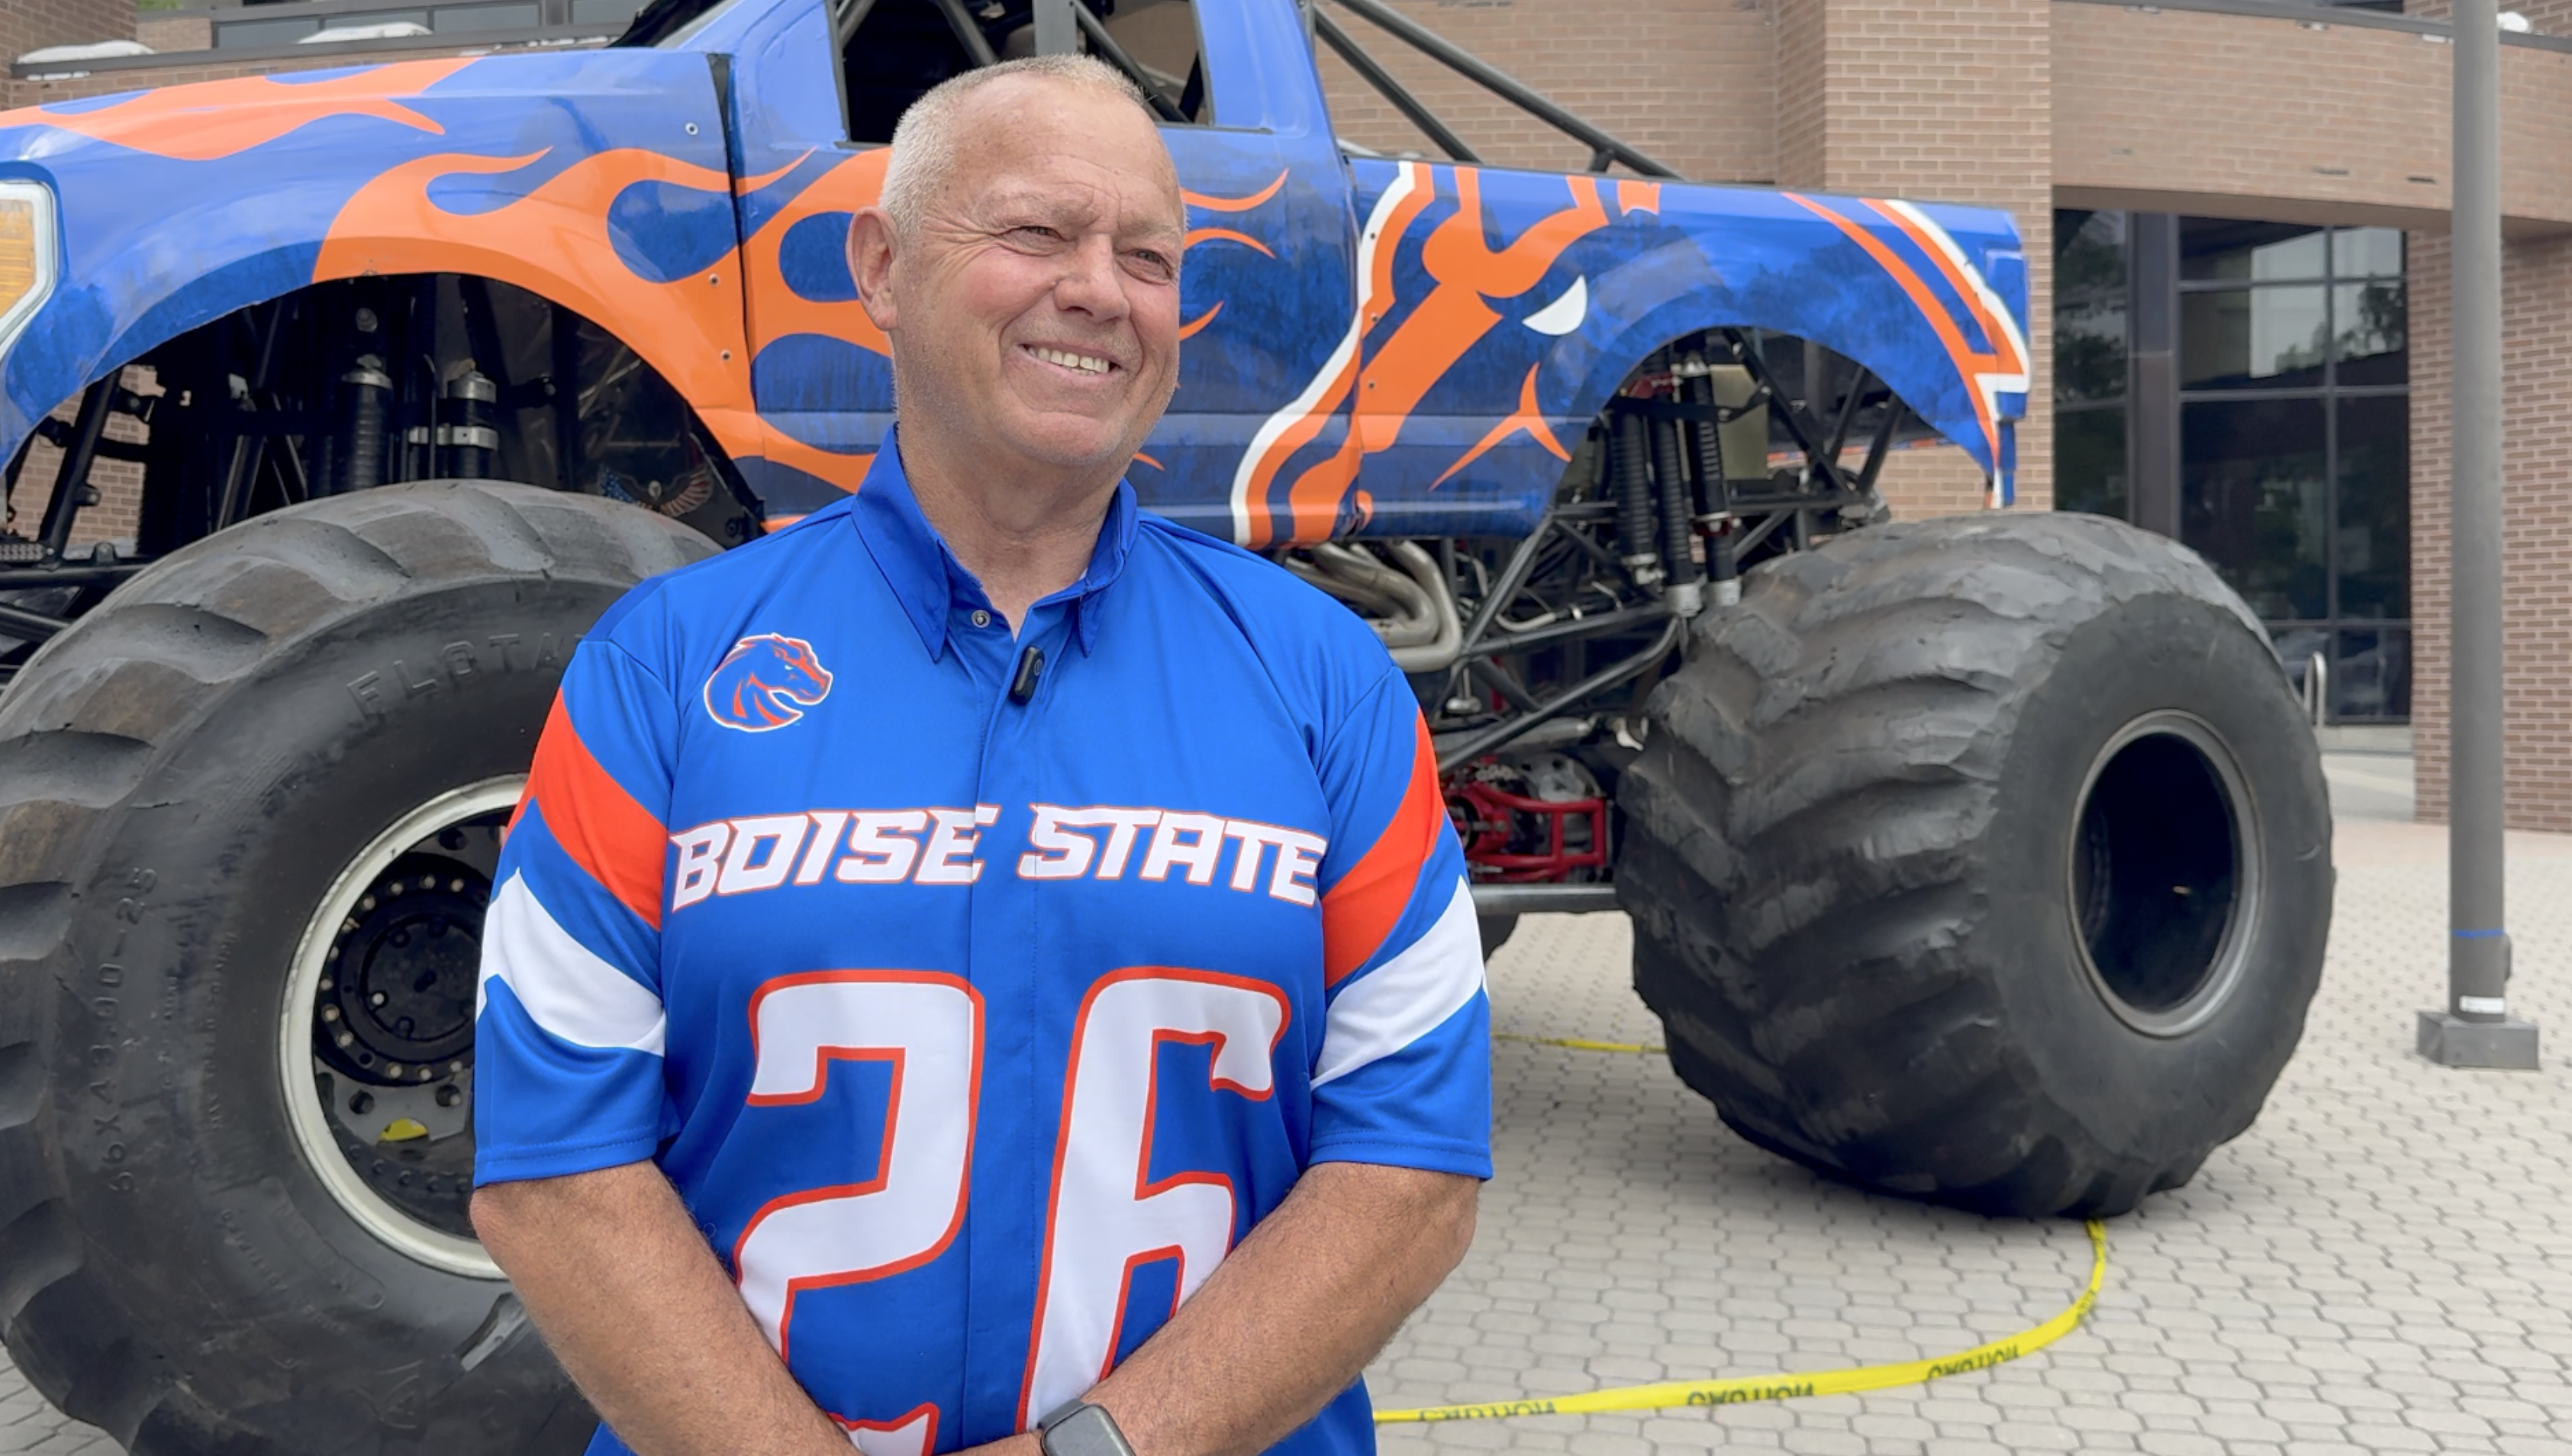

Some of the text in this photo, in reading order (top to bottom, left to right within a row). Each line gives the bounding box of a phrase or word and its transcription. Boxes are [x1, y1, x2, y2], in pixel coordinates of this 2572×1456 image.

[669, 802, 1328, 913] BOISE STATE
[733, 966, 1292, 1456] 26
